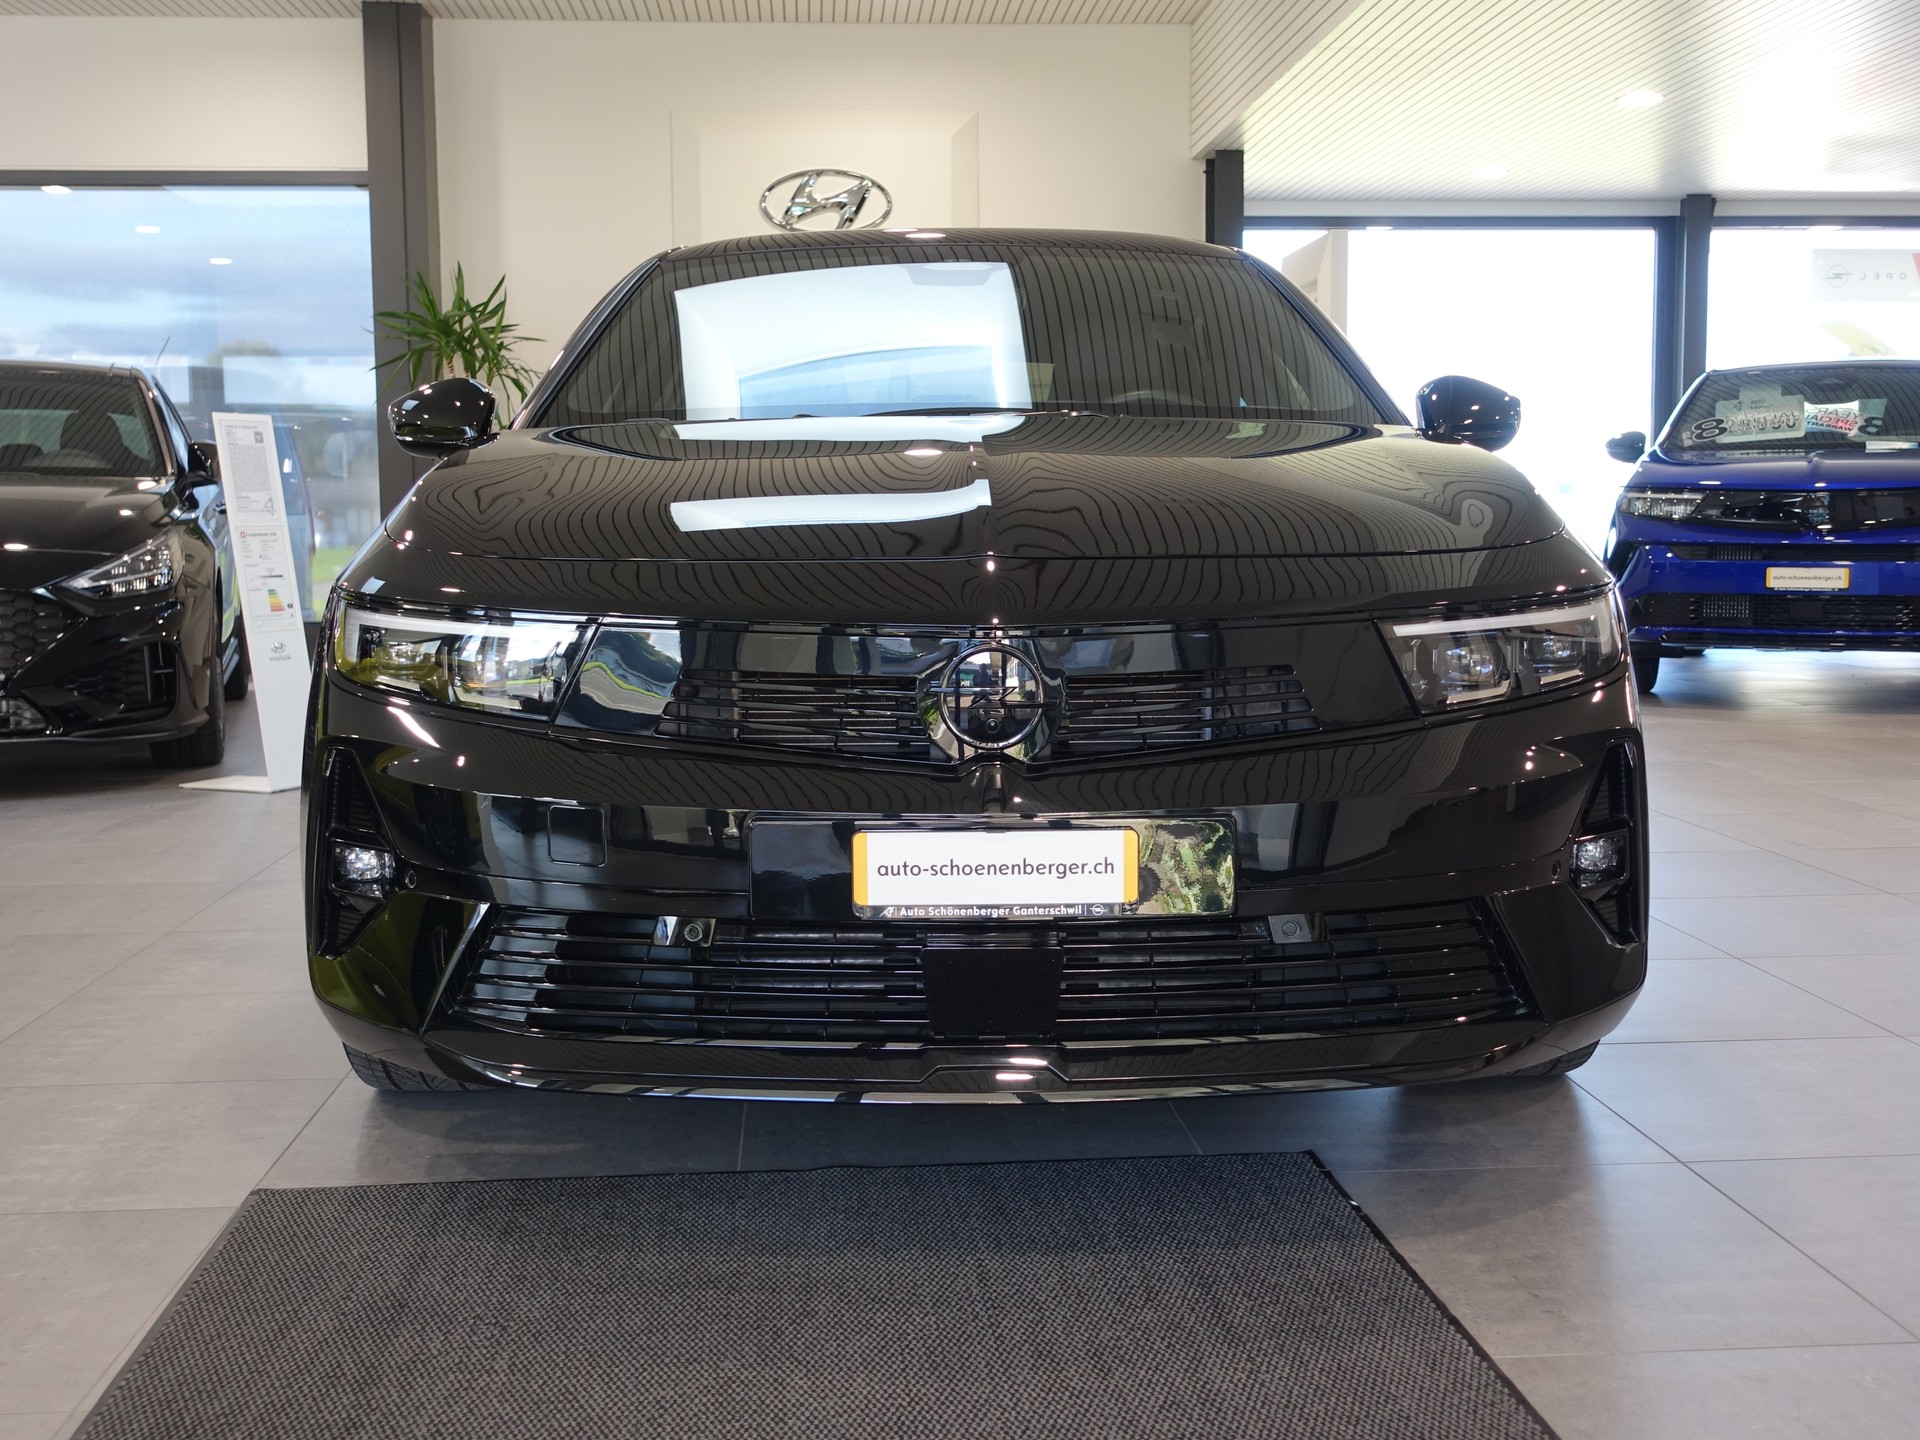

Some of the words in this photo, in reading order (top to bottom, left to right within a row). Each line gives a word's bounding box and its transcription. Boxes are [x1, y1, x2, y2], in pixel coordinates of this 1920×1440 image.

[1692, 416, 1730, 442] 8
[877, 856, 1115, 879] auto-schoenenberger.ch
[899, 906, 926, 916] Auto
[927, 905, 1010, 917] Schönenberger
[1013, 904, 1082, 915] Ganterschwil
